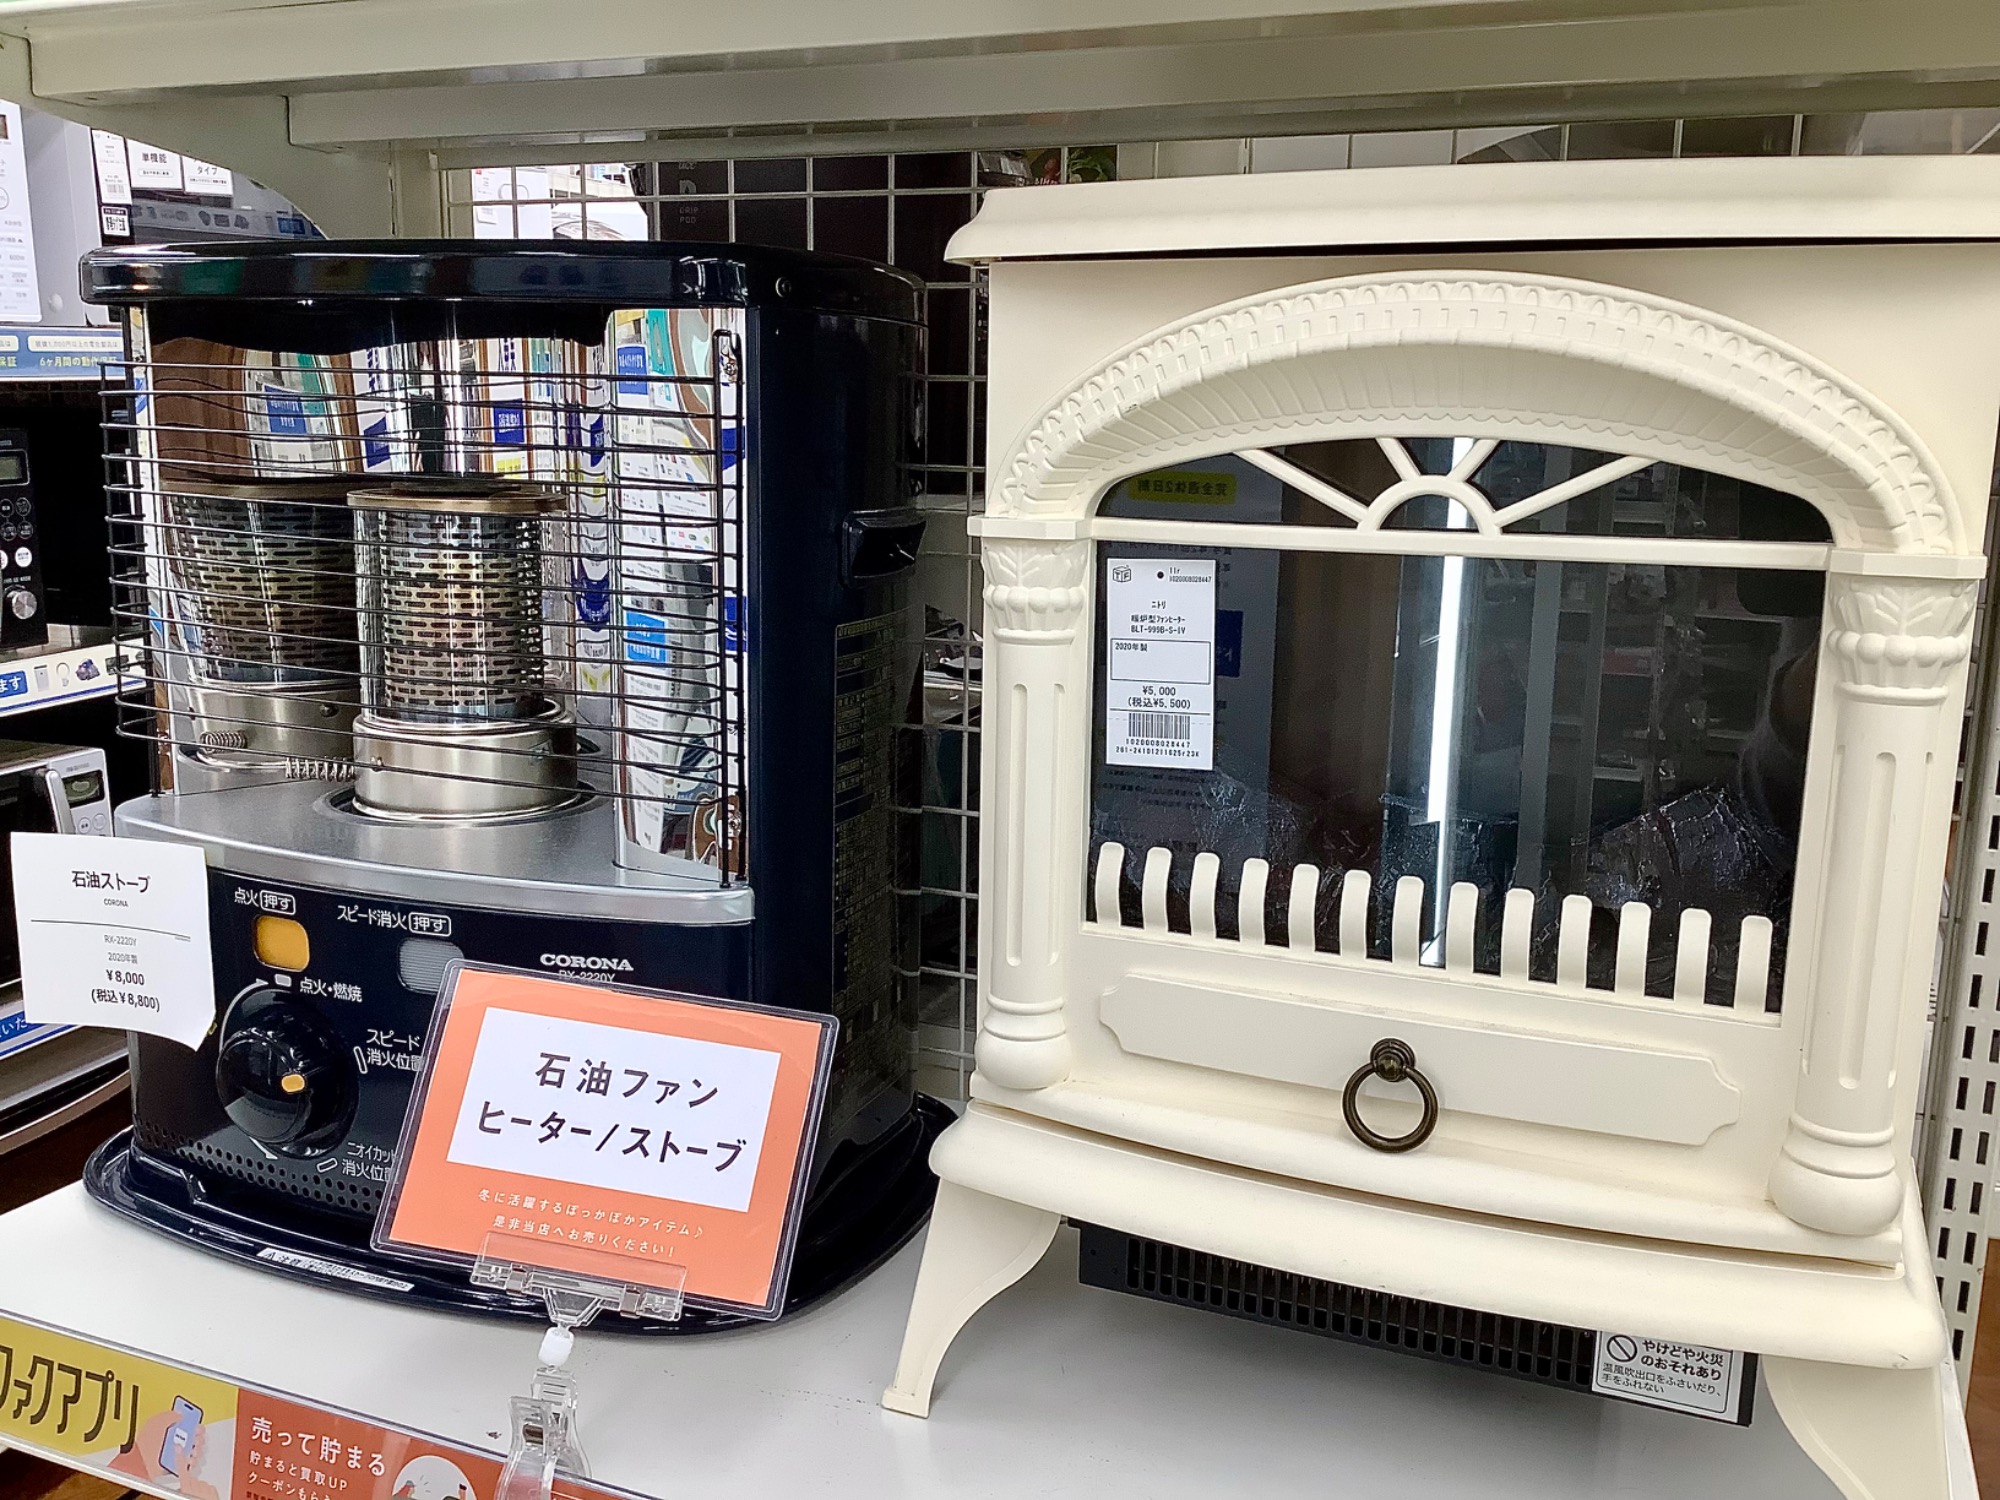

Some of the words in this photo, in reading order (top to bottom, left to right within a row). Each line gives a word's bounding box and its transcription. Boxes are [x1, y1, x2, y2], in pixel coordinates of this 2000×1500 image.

[1115, 642, 1148, 652] 2020年製
[1142, 685, 1177, 697] ¥5,000
[1125, 738, 1191, 748] 1020008028447
[71, 870, 151, 894] 石油ストーブ
[103, 898, 129, 908] CORONA
[234, 887, 259, 907] 点火
[263, 894, 291, 911] 押す
[337, 905, 407, 930] スピード消火
[413, 916, 447, 932] 押す
[539, 953, 634, 972] CORONA
[106, 969, 145, 987] ¥8,000
[300, 976, 363, 1002] 点火・燃焼
[91, 988, 160, 1012] (税込¥8,800)
[366, 1028, 420, 1051] スピード
[534, 1050, 719, 1109] 石油ファン
[477, 1100, 747, 1173] ヒーター/ストーブ
[1641, 1339, 1724, 1368] やけどや火災
[1602, 1362, 1722, 1397] 温風吹出口をふさいだり、
[1640, 1354, 1722, 1381] のおそれあり
[1602, 1373, 1665, 1393] 手をふれない
[251, 1416, 386, 1477] 売って貯まる
[249, 1450, 348, 1491] 貯まると買取UP
